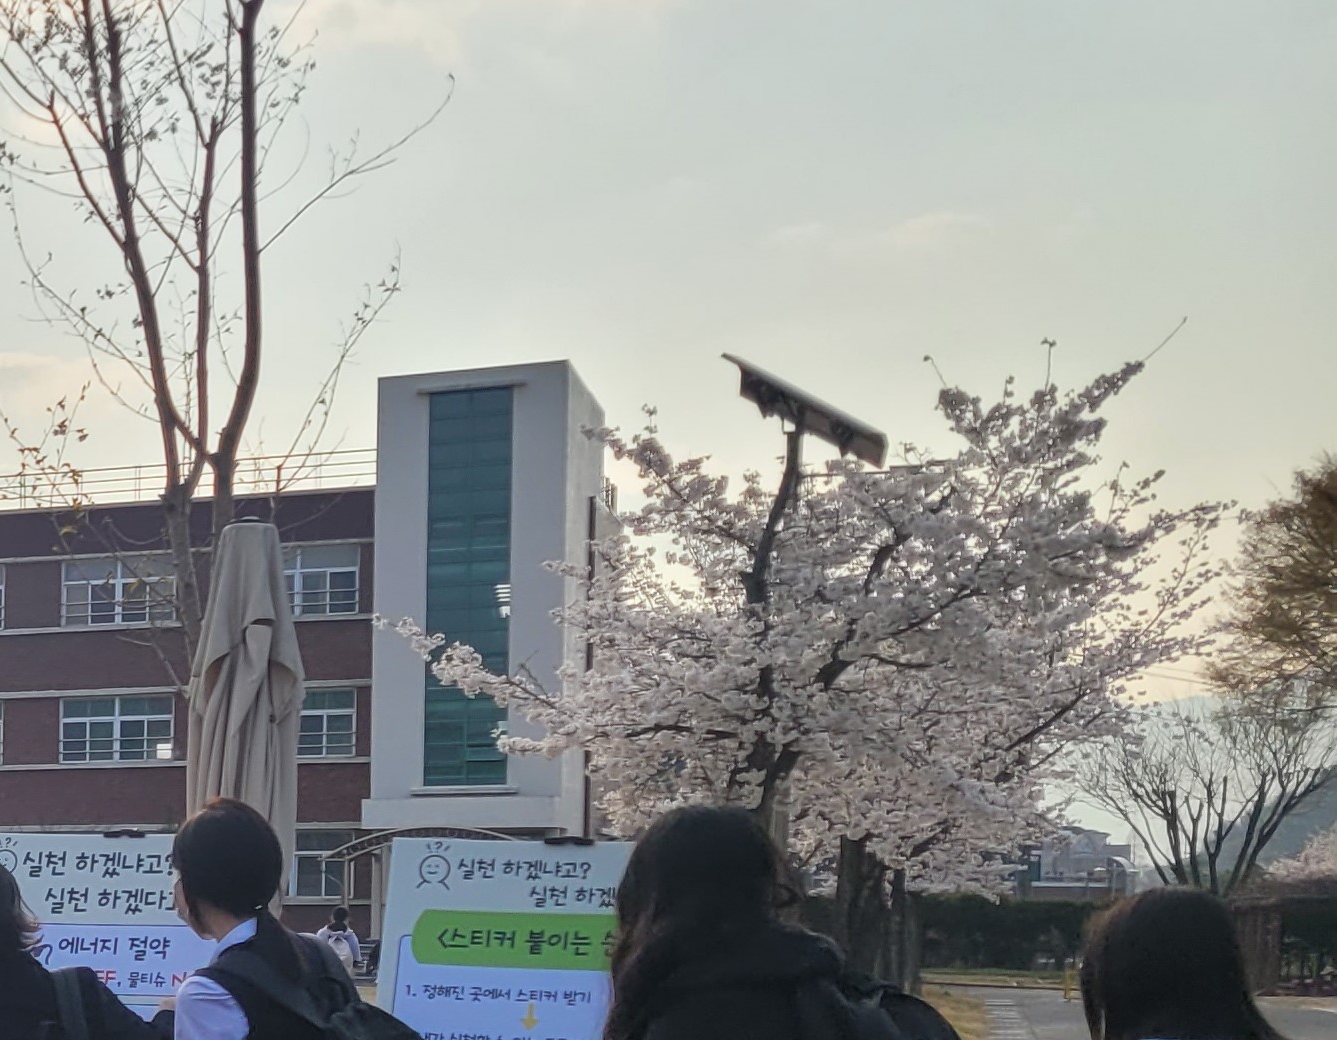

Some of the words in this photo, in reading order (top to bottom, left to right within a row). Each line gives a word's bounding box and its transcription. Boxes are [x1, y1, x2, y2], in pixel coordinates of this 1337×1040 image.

[23, 851, 67, 877] 실천
[76, 851, 174, 878] 하겠냐고?
[458, 858, 495, 880] 실천
[503, 860, 591, 881] 하겠냐고?
[45, 887, 89, 914] 실천
[530, 886, 568, 908] 실천
[58, 936, 118, 955] 에너지
[128, 936, 170, 961] 절약
[438, 928, 516, 949] <스티커
[525, 929, 592, 956] 붙이는
[128, 971, 166, 988] 물티슈
[405, 984, 417, 997] 1.
[423, 985, 465, 1001] 정해진
[469, 986, 511, 1002] 곳에서
[515, 988, 558, 1002] 스티커
[563, 990, 591, 1006] 받기
